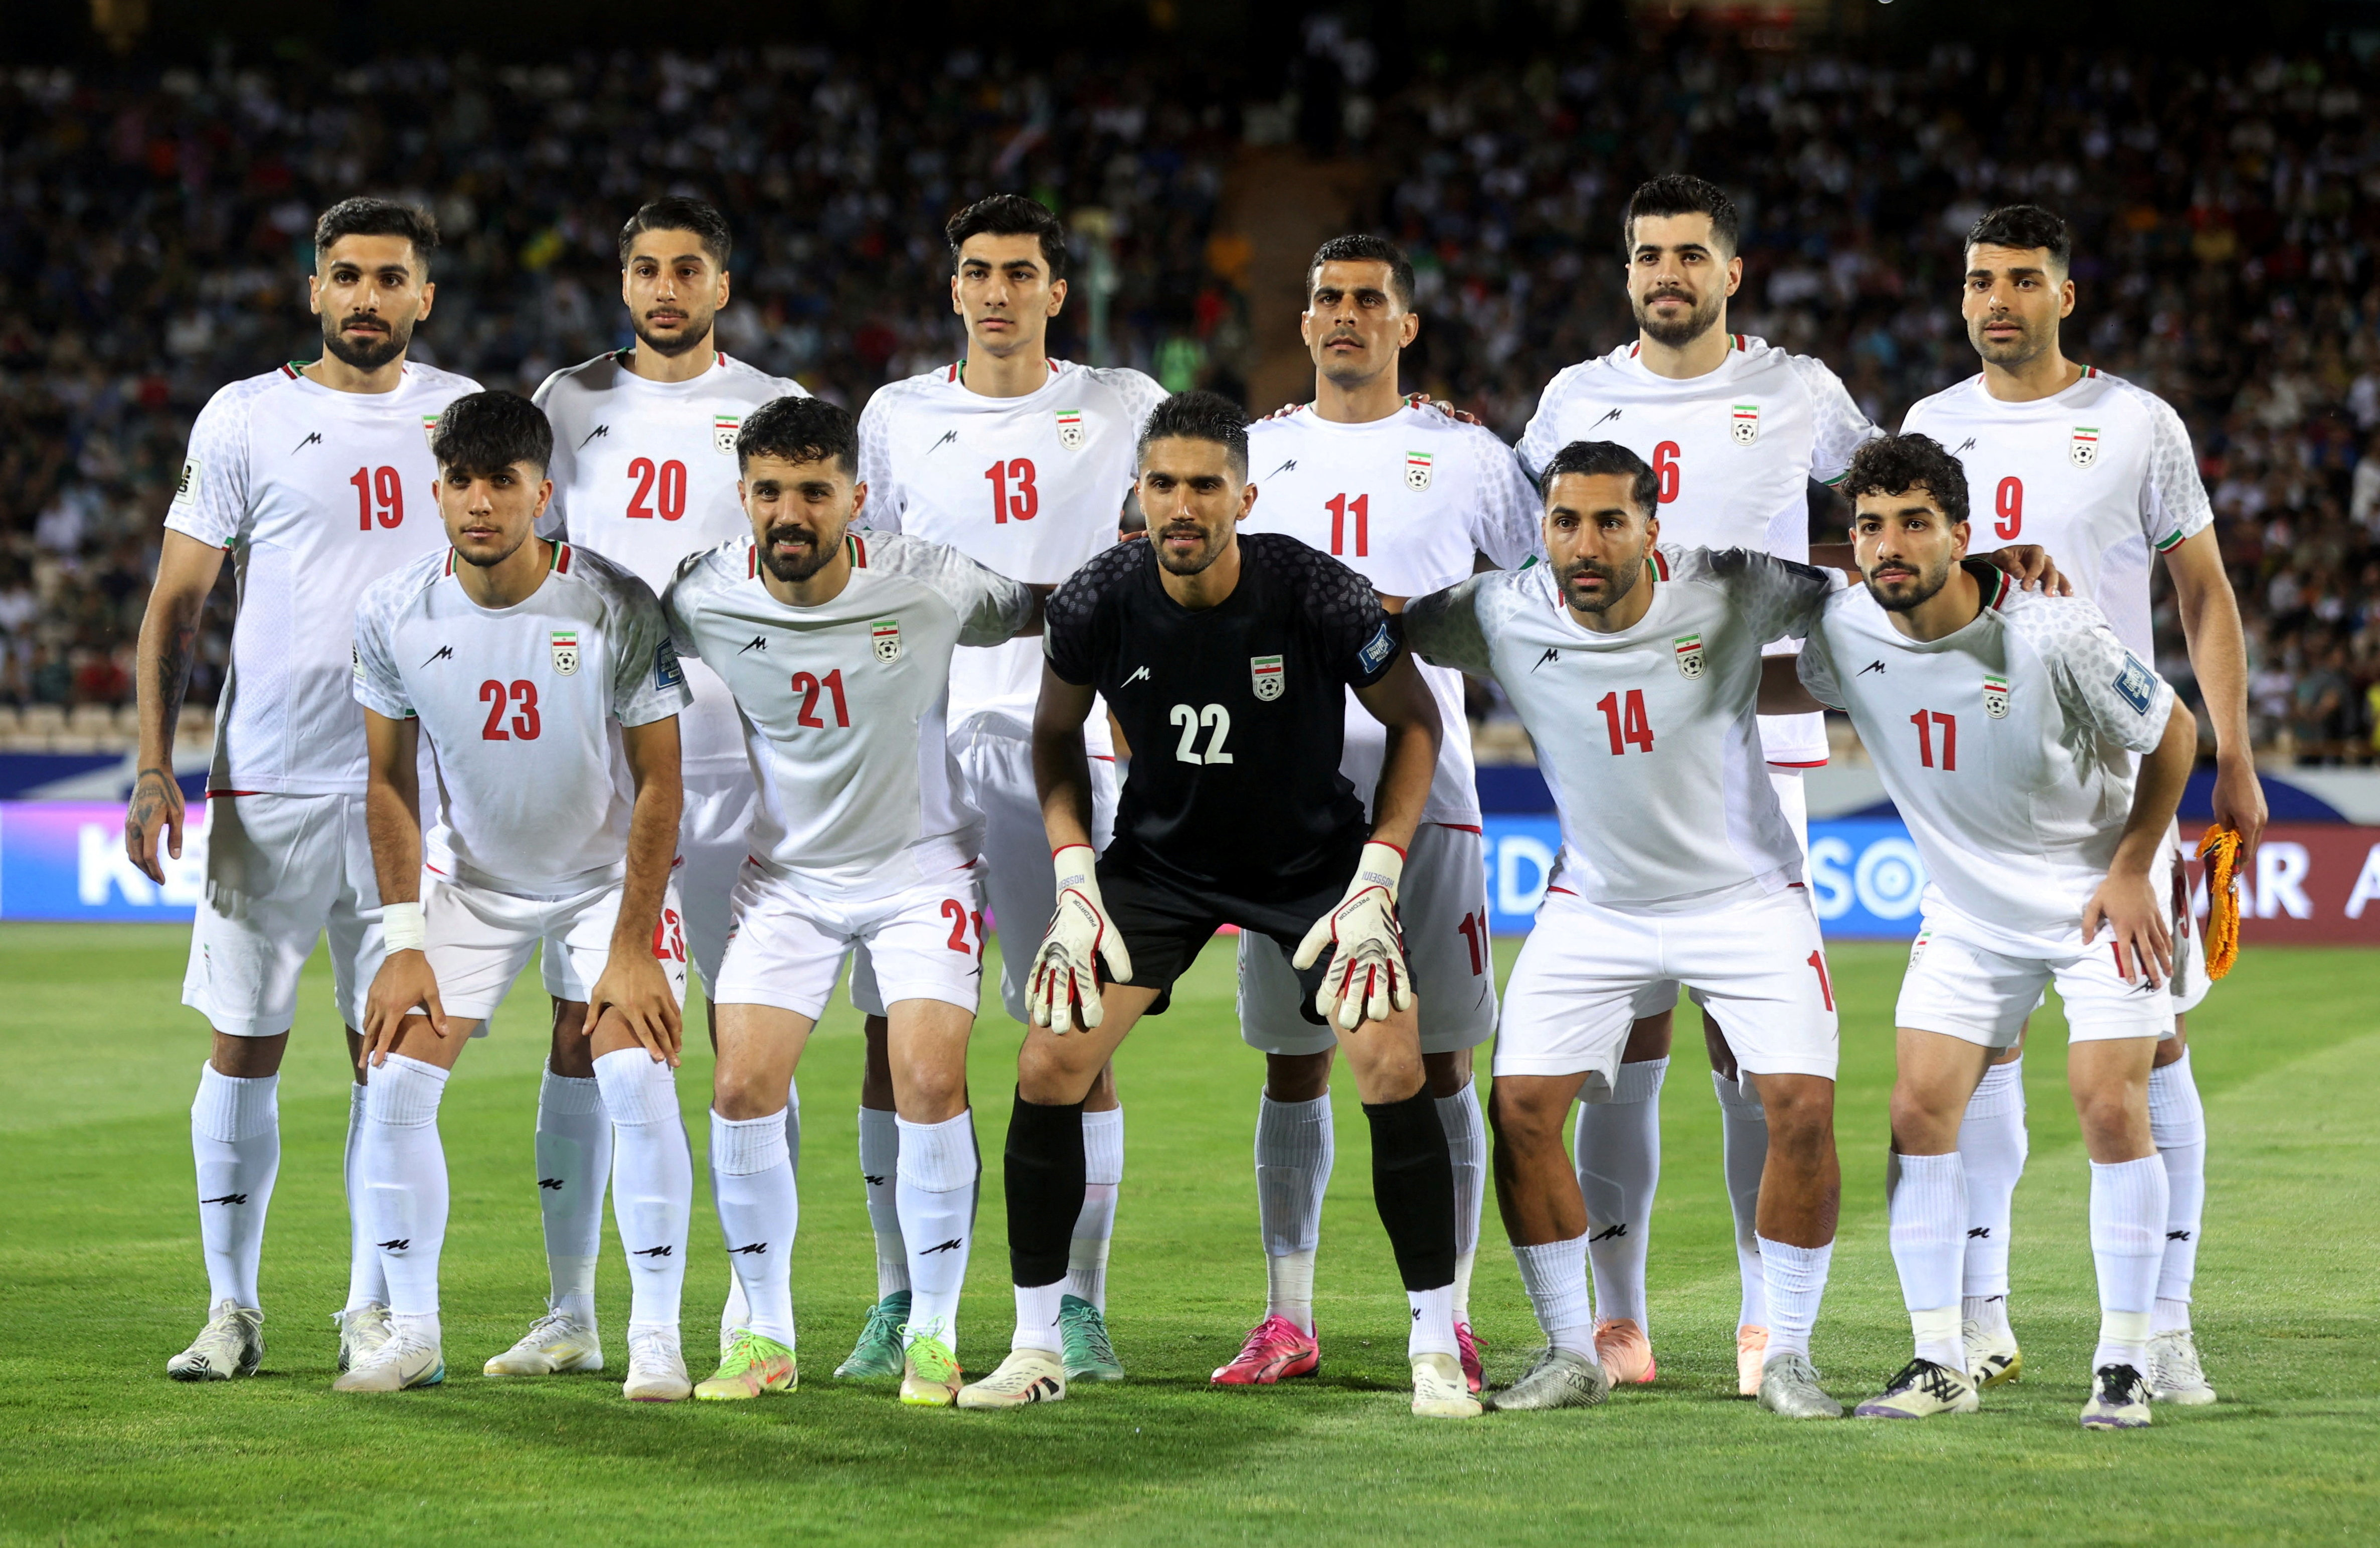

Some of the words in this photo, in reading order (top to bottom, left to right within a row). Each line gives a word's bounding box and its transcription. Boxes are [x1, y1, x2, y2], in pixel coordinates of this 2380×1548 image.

[351, 466, 404, 531] 19
[626, 457, 687, 521] 20
[984, 457, 1038, 524] 13
[1652, 440, 1680, 504] 6
[1324, 493, 1368, 557] 11
[1994, 476, 2023, 541] 9
[479, 679, 541, 741] 23
[791, 669, 850, 729] 21
[1597, 689, 1654, 755] 14
[1170, 703, 1234, 765] 22
[1910, 708, 1956, 771] 17
[1337, 896, 1371, 921] PREDATOR
[1362, 871, 1394, 889] HOSSEINI
[941, 898, 984, 966] 21
[1072, 899, 1097, 927] PREDATOR
[1806, 950, 1834, 1012] 1
